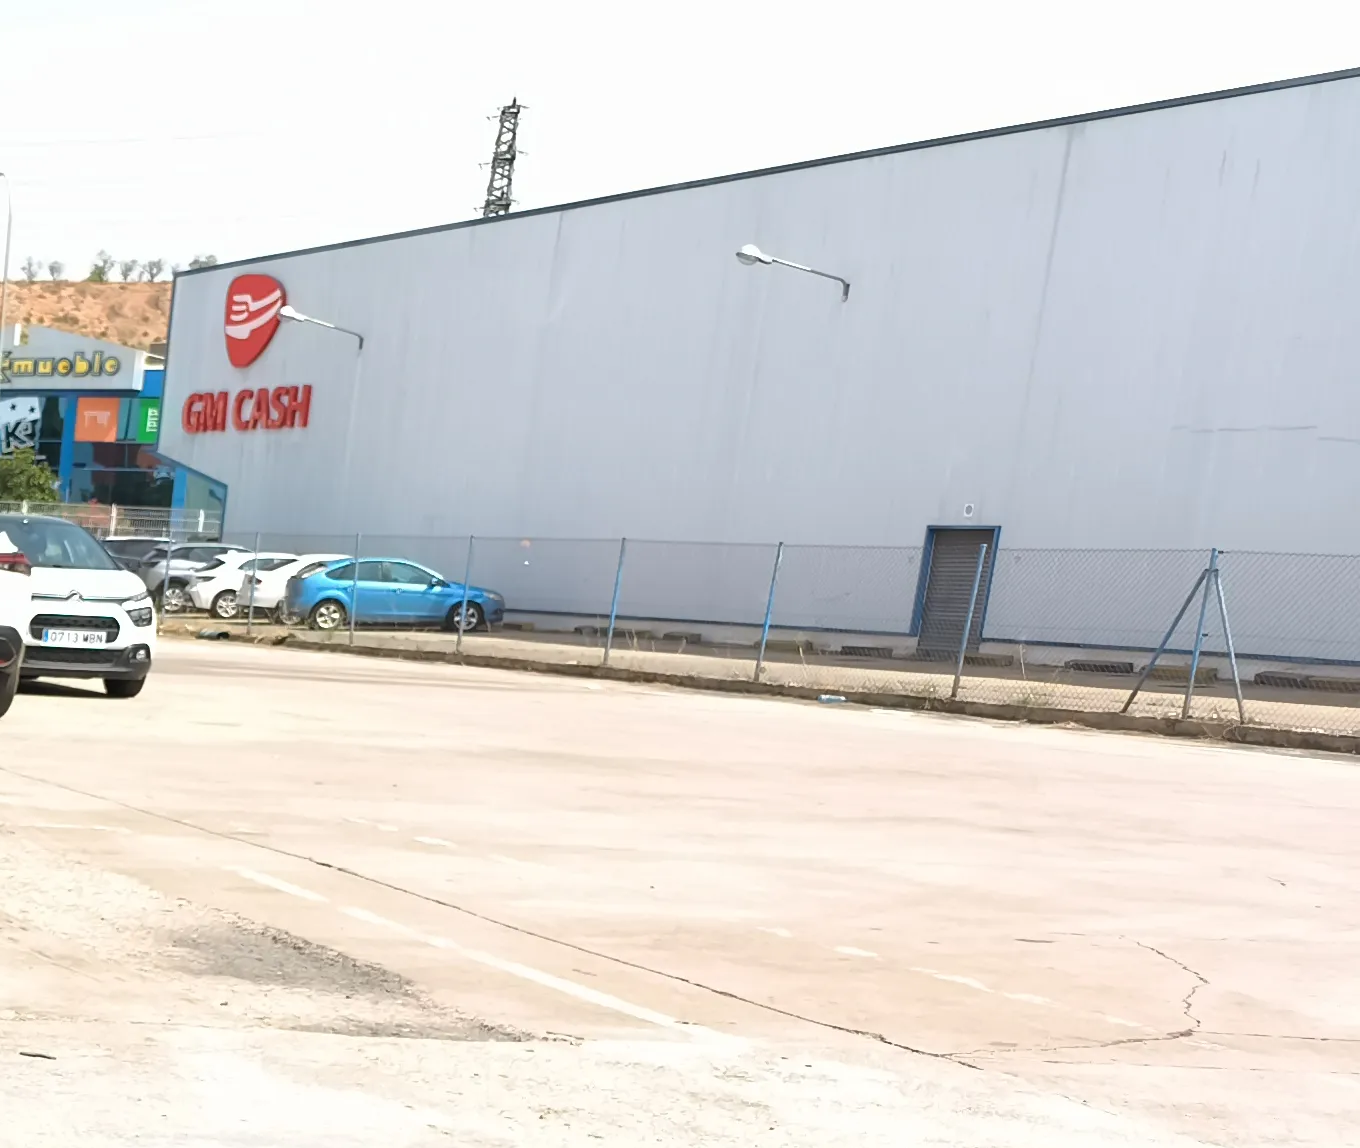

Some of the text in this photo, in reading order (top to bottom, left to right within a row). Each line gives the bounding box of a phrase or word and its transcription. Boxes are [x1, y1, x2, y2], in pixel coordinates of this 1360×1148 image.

[182, 384, 312, 434] GM CASH
[50, 631, 79, 644] 0713
